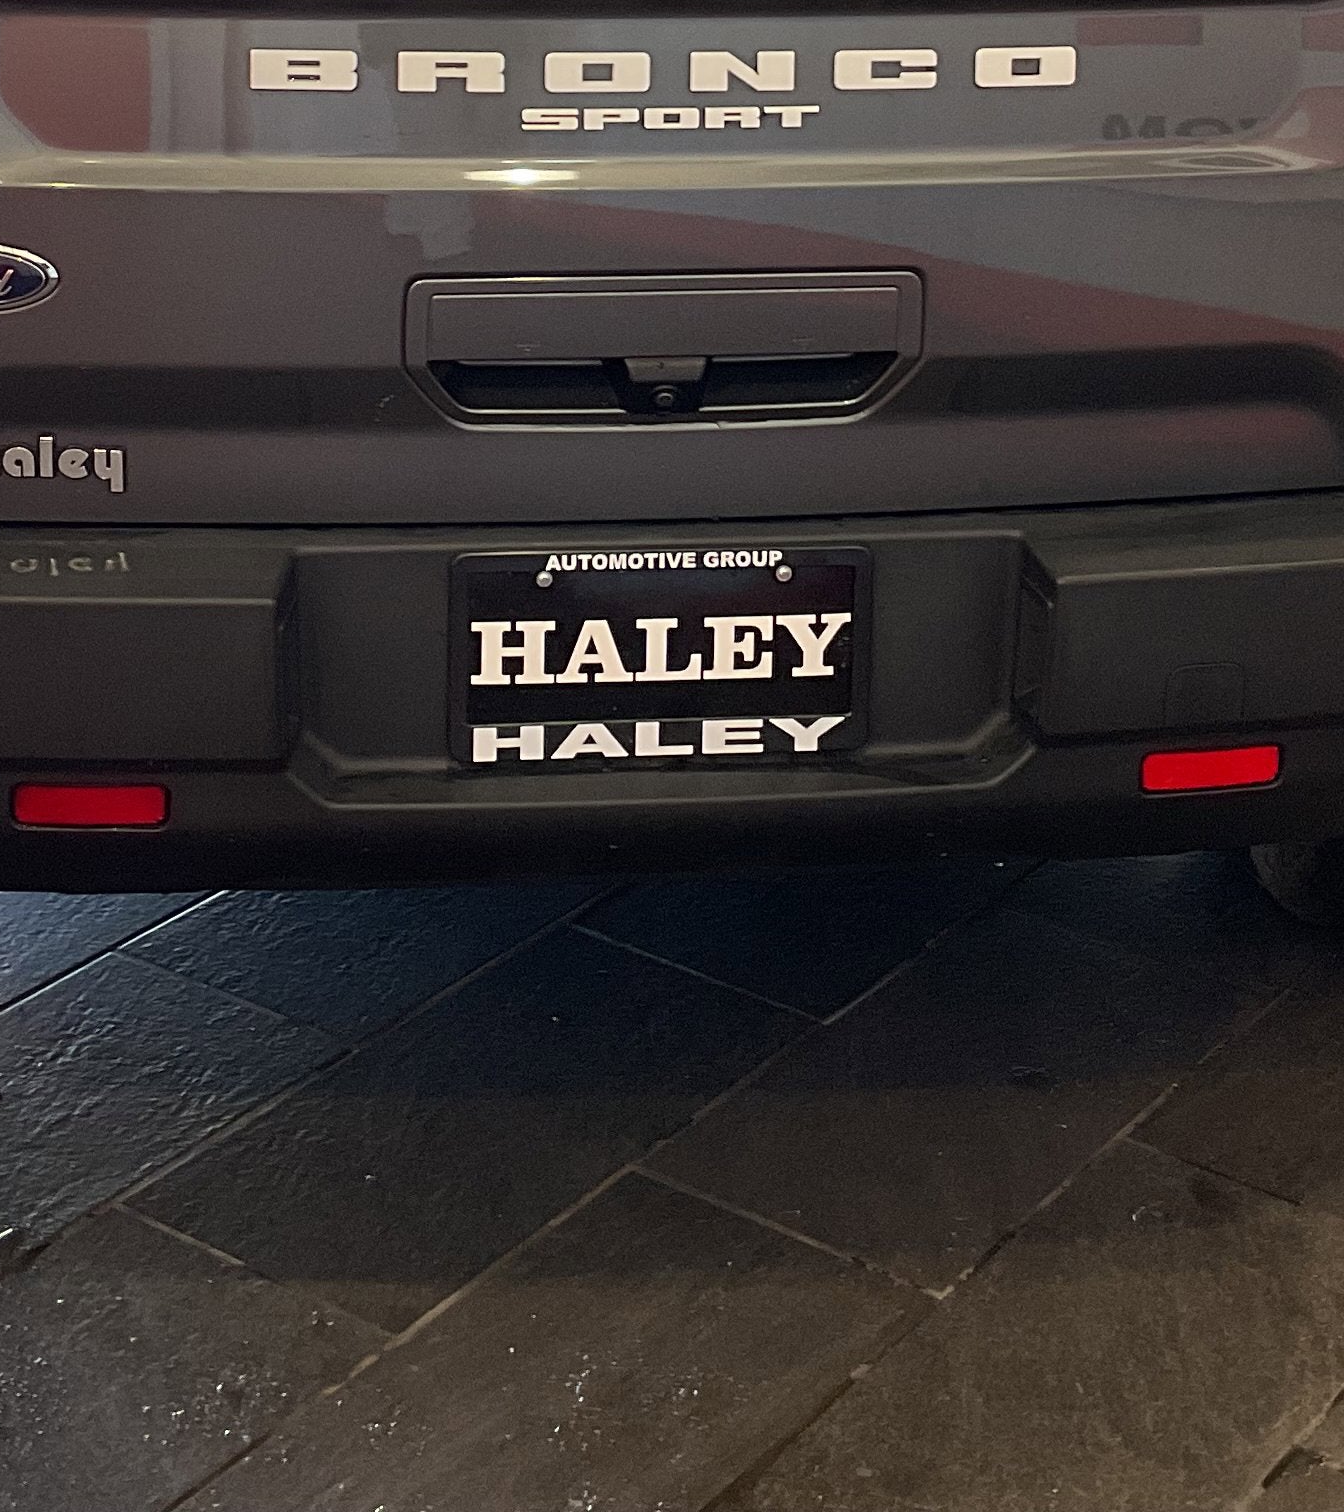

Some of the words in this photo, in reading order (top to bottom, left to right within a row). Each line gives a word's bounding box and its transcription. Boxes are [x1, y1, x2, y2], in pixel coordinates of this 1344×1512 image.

[248, 44, 1078, 94] BRONCO
[520, 104, 821, 132] SPORT
[545, 552, 697, 572] AUTOMOTIVE
[702, 550, 784, 569] GROUP
[469, 611, 852, 686] HALEY
[472, 715, 846, 763] HALEY
